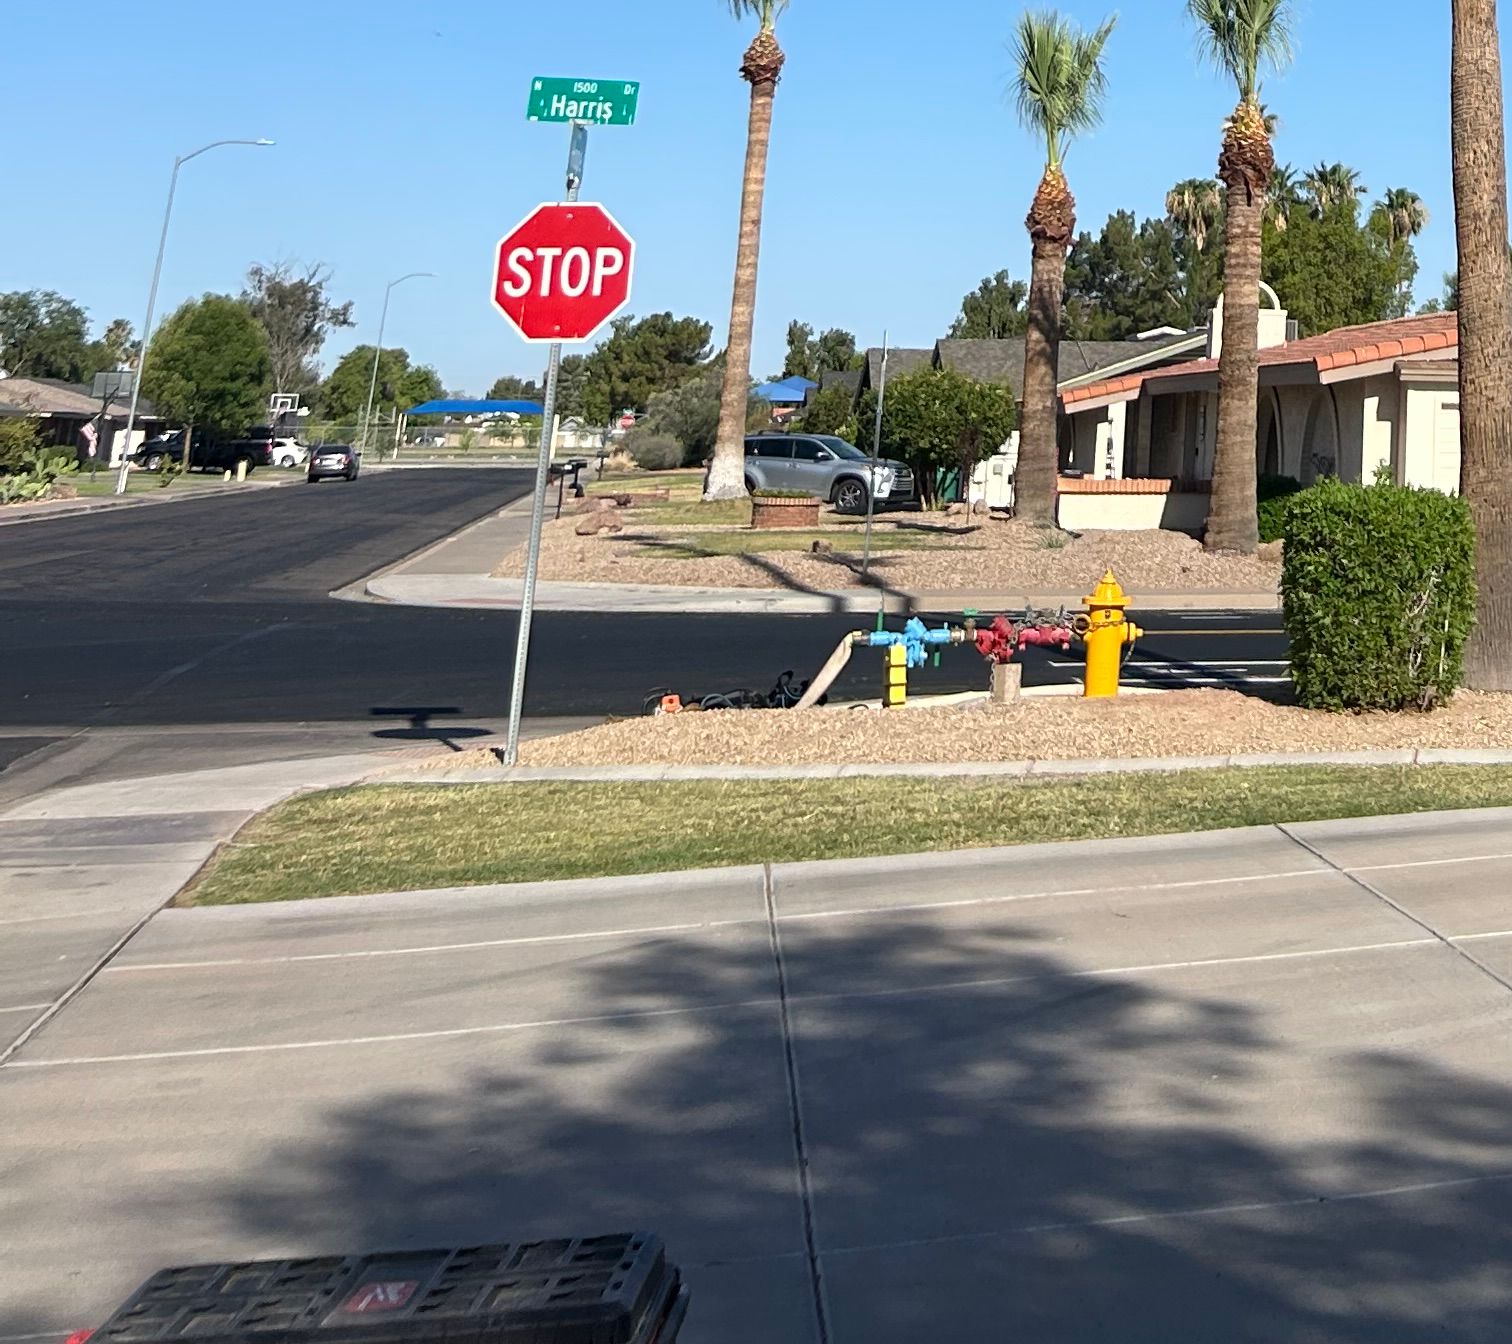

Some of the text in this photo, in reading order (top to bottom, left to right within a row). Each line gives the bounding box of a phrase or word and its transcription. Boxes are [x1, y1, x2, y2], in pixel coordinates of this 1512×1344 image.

[534, 80, 636, 95] N 1500 Dr
[550, 94, 613, 120] Harris
[503, 246, 624, 298] STOP
